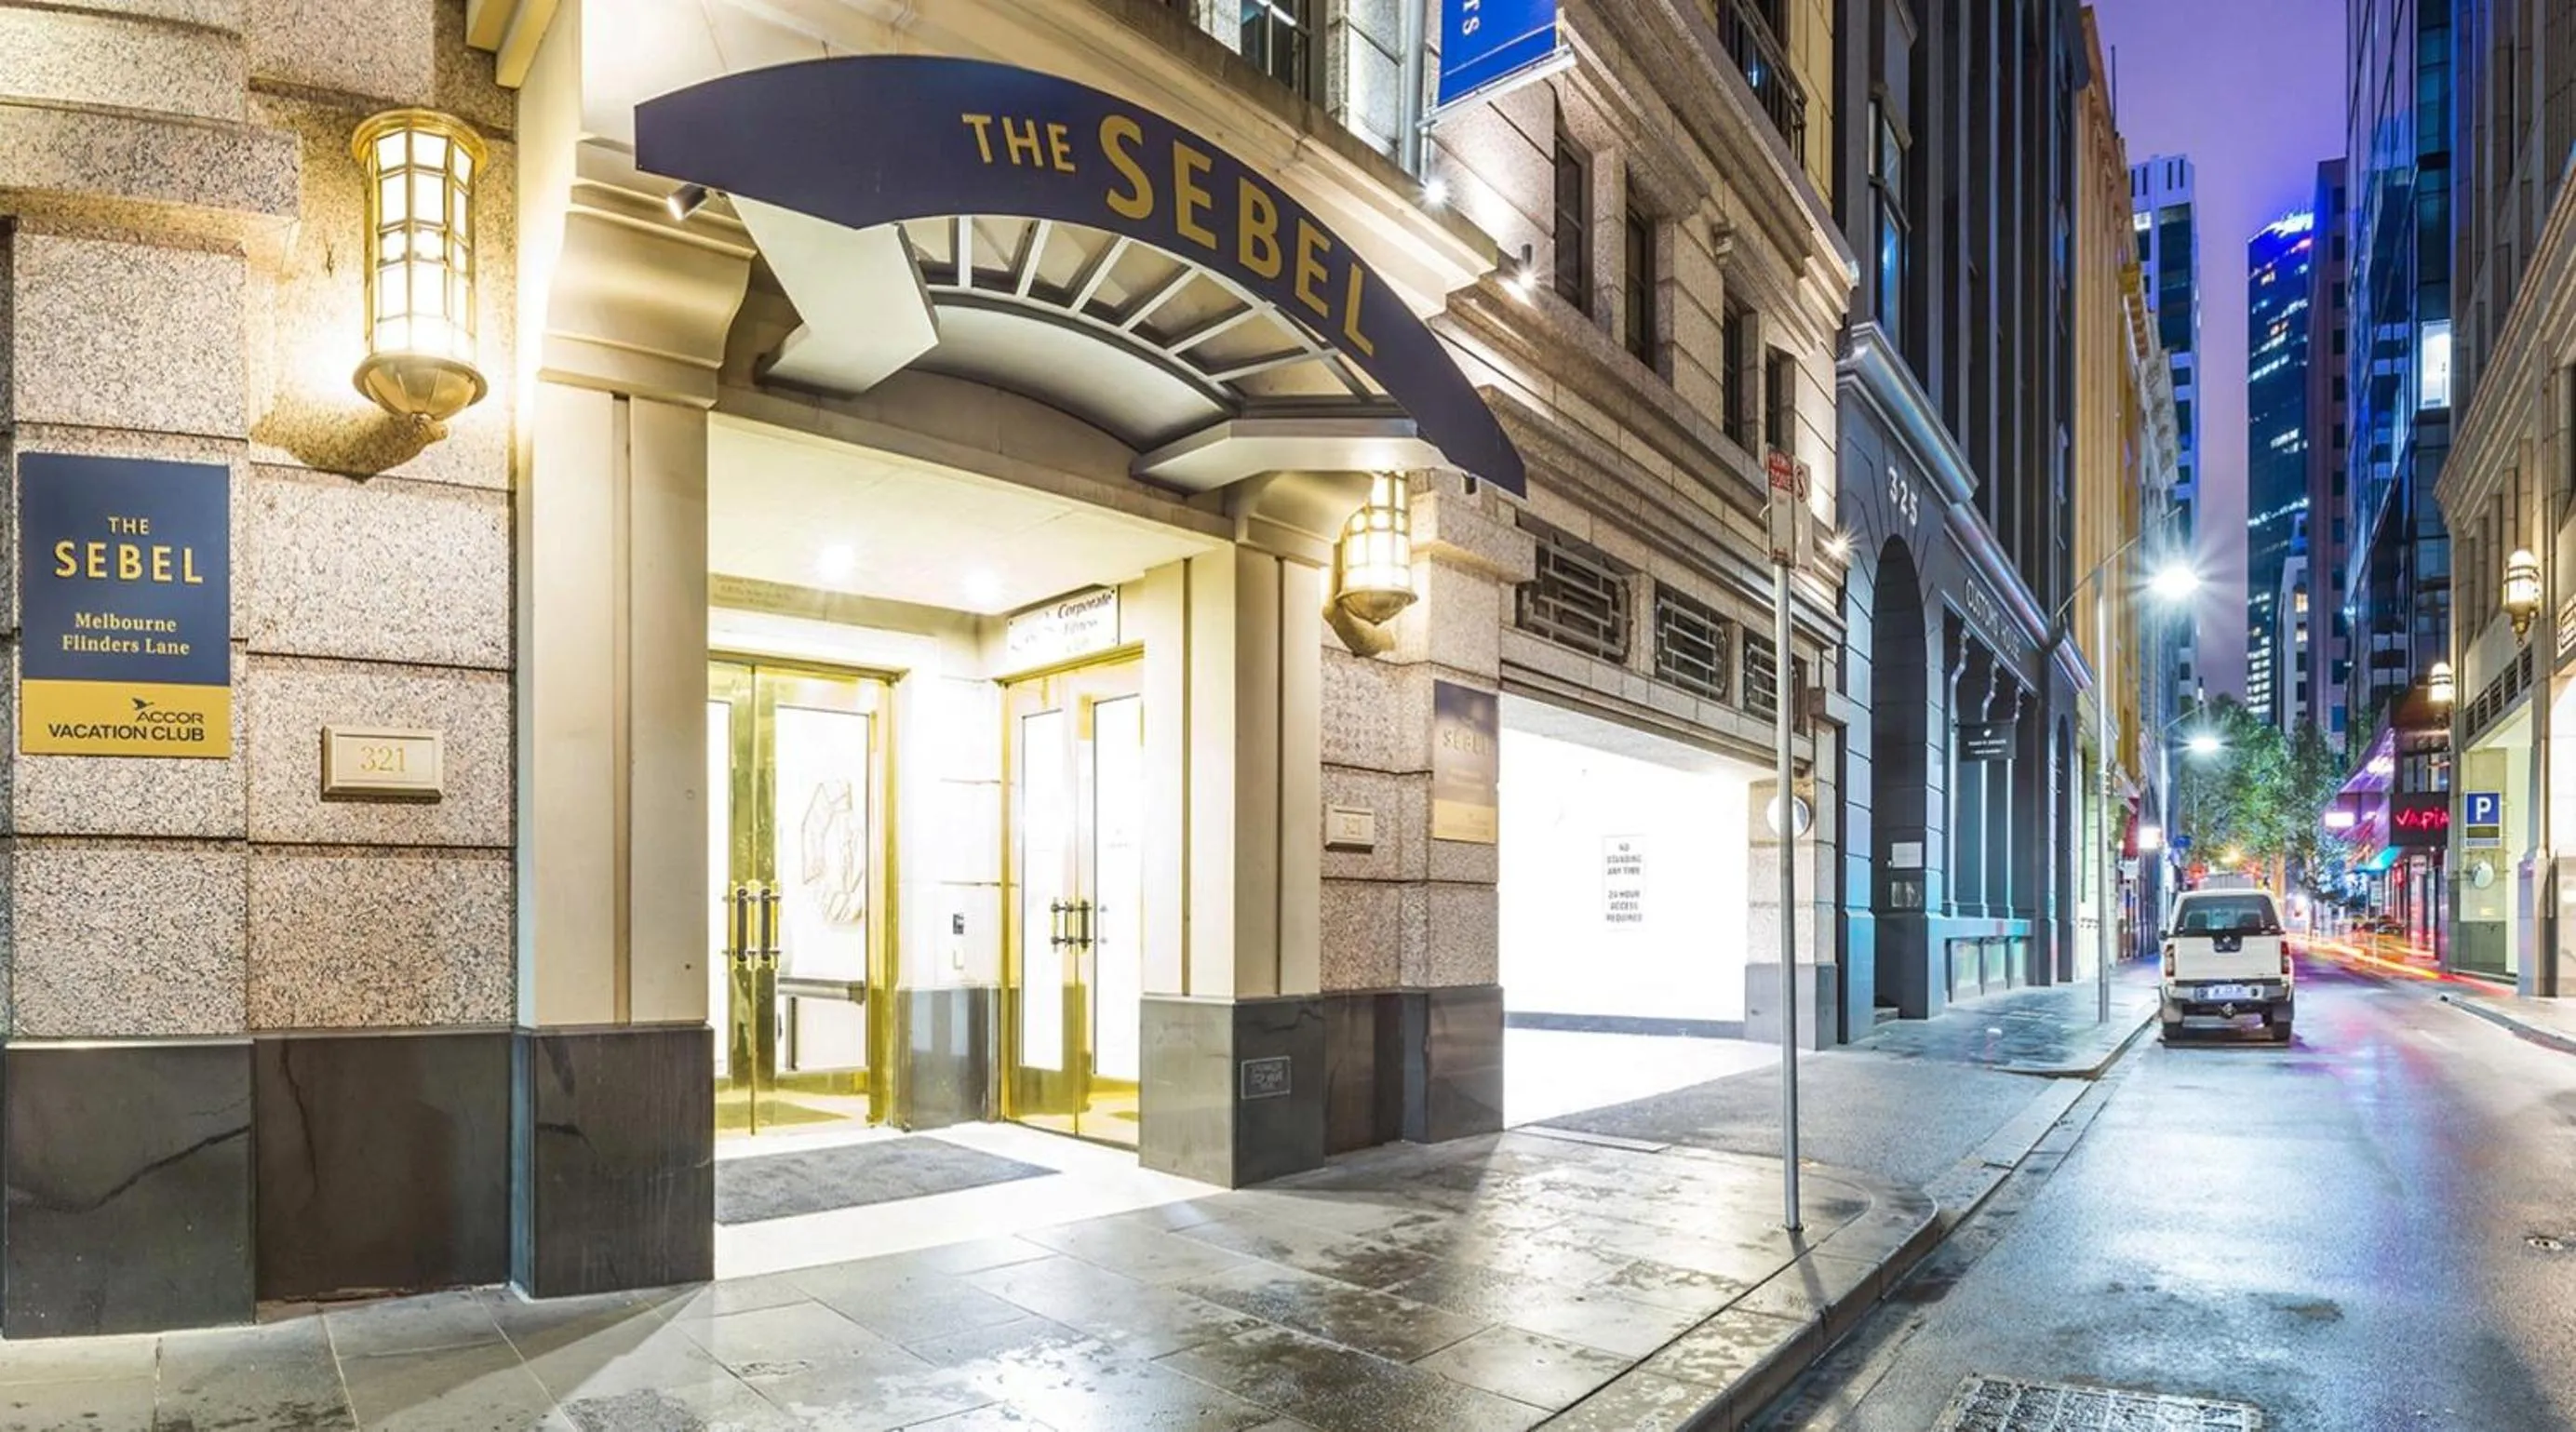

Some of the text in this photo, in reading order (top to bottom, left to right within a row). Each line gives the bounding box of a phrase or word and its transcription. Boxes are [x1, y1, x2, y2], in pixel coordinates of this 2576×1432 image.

[961, 113, 1375, 358] THE SEBEL
[1887, 465, 1918, 528] 325
[107, 515, 151, 536] THE
[53, 540, 205, 584] SEBEL
[74, 611, 178, 634] Melbourne
[61, 634, 191, 656] Flinders Lane
[136, 711, 204, 725] ACCOR
[48, 723, 205, 743] VACATION CLUB
[359, 744, 406, 773] 321
[2475, 796, 2491, 822] P
[1618, 843, 1630, 852] NO
[1606, 854, 1642, 864] STANDING
[1607, 866, 1621, 876] ANY
[1608, 890, 1641, 900] 24 HOUR
[1610, 901, 1639, 911] ACCESS
